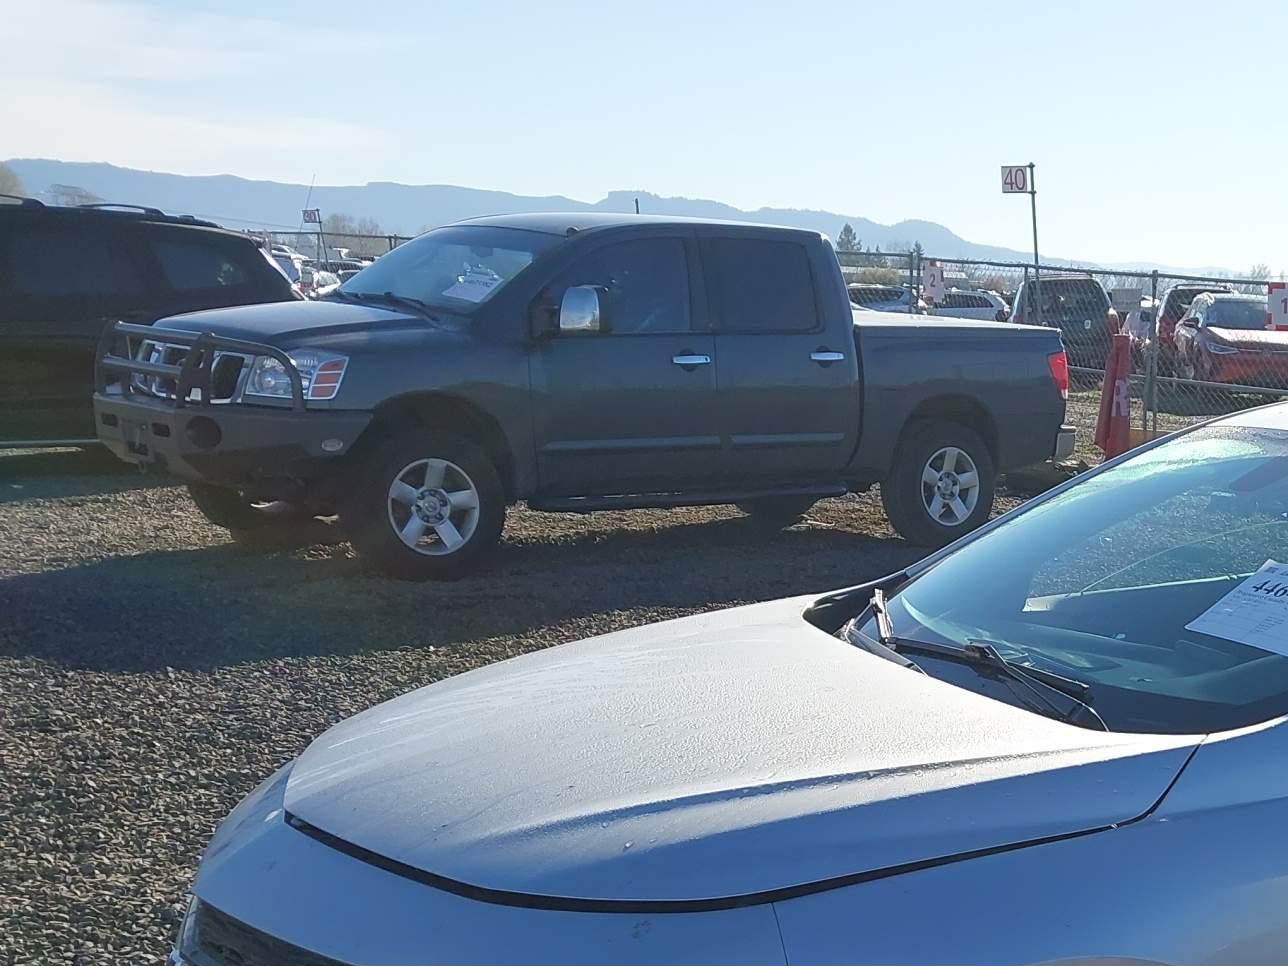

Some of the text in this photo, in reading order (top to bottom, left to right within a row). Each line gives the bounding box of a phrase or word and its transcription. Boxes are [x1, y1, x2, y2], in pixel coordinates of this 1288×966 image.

[1003, 167, 1026, 191] 40
[929, 272, 936, 288] 2
[1280, 297, 1288, 315] 1
